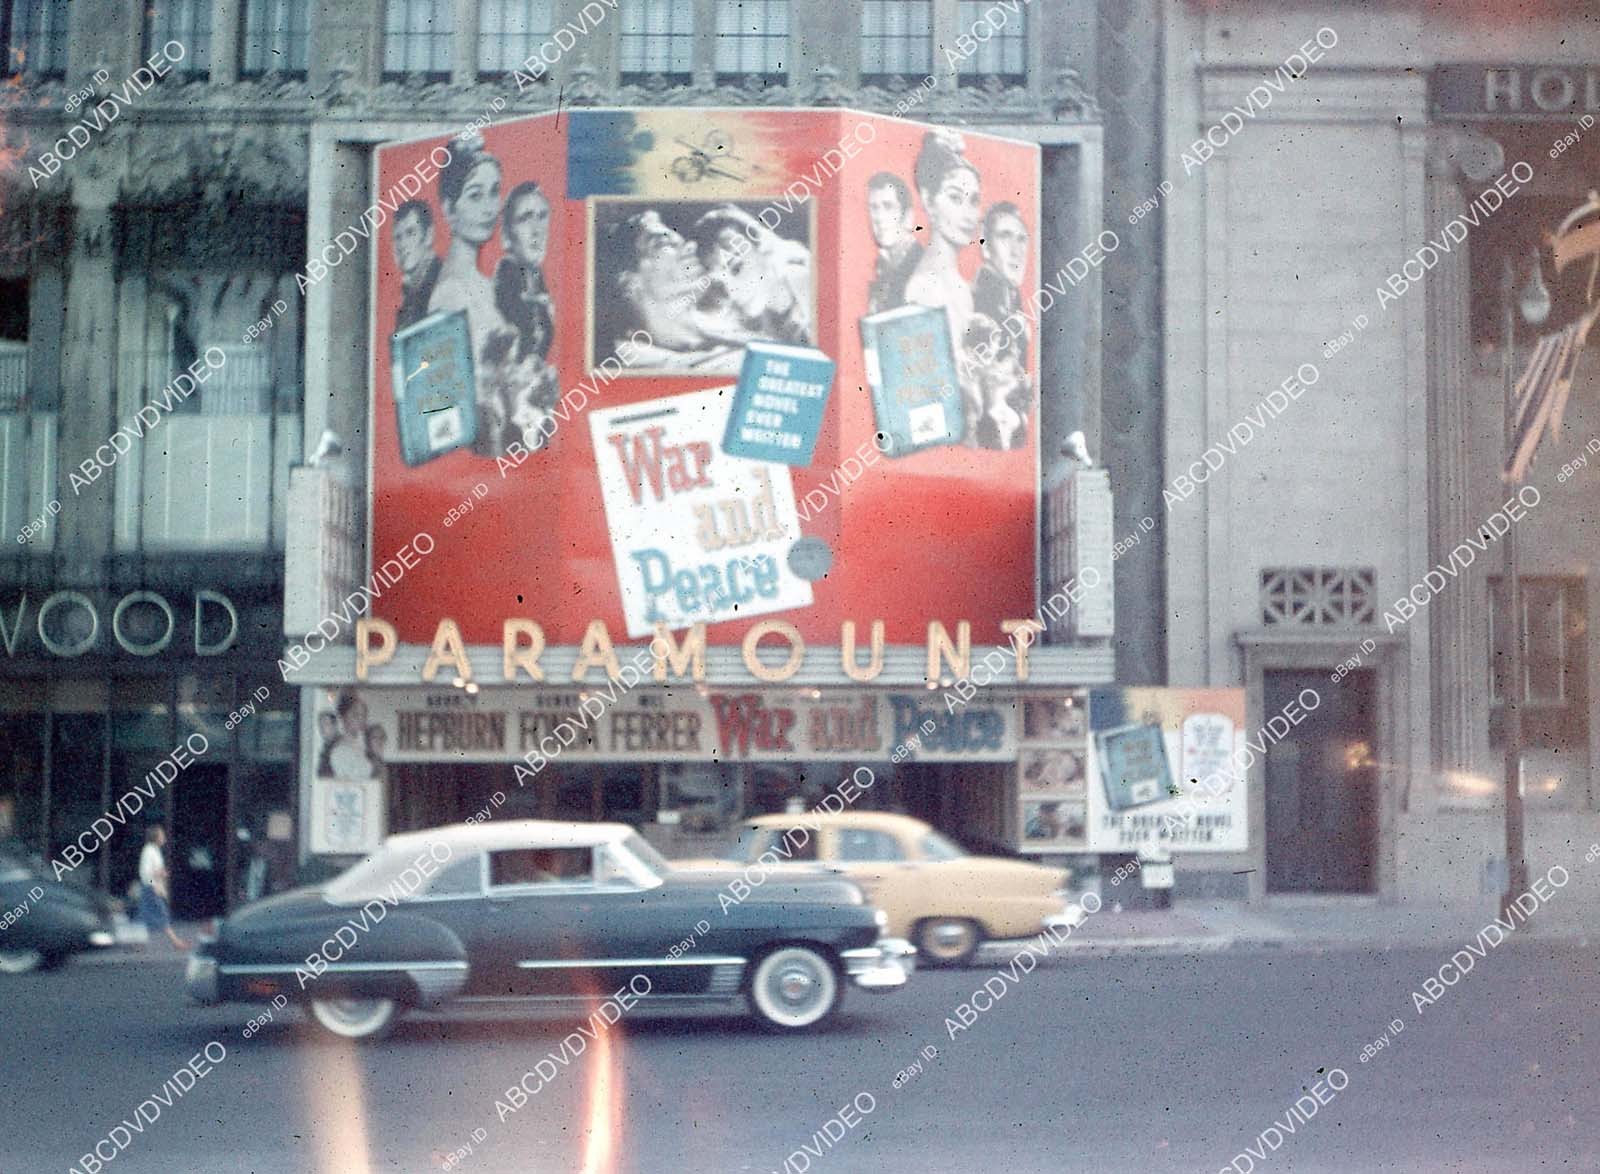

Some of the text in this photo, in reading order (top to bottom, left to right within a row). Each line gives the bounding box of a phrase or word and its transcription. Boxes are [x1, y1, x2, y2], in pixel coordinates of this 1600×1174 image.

[606, 426, 714, 506] War
[693, 465, 787, 551] and
[630, 548, 778, 623] Peace
[356, 618, 1042, 682] PARAMOUNT
[610, 711, 702, 750] FERRER
[709, 694, 797, 758] War
[887, 694, 1004, 758] Peace
